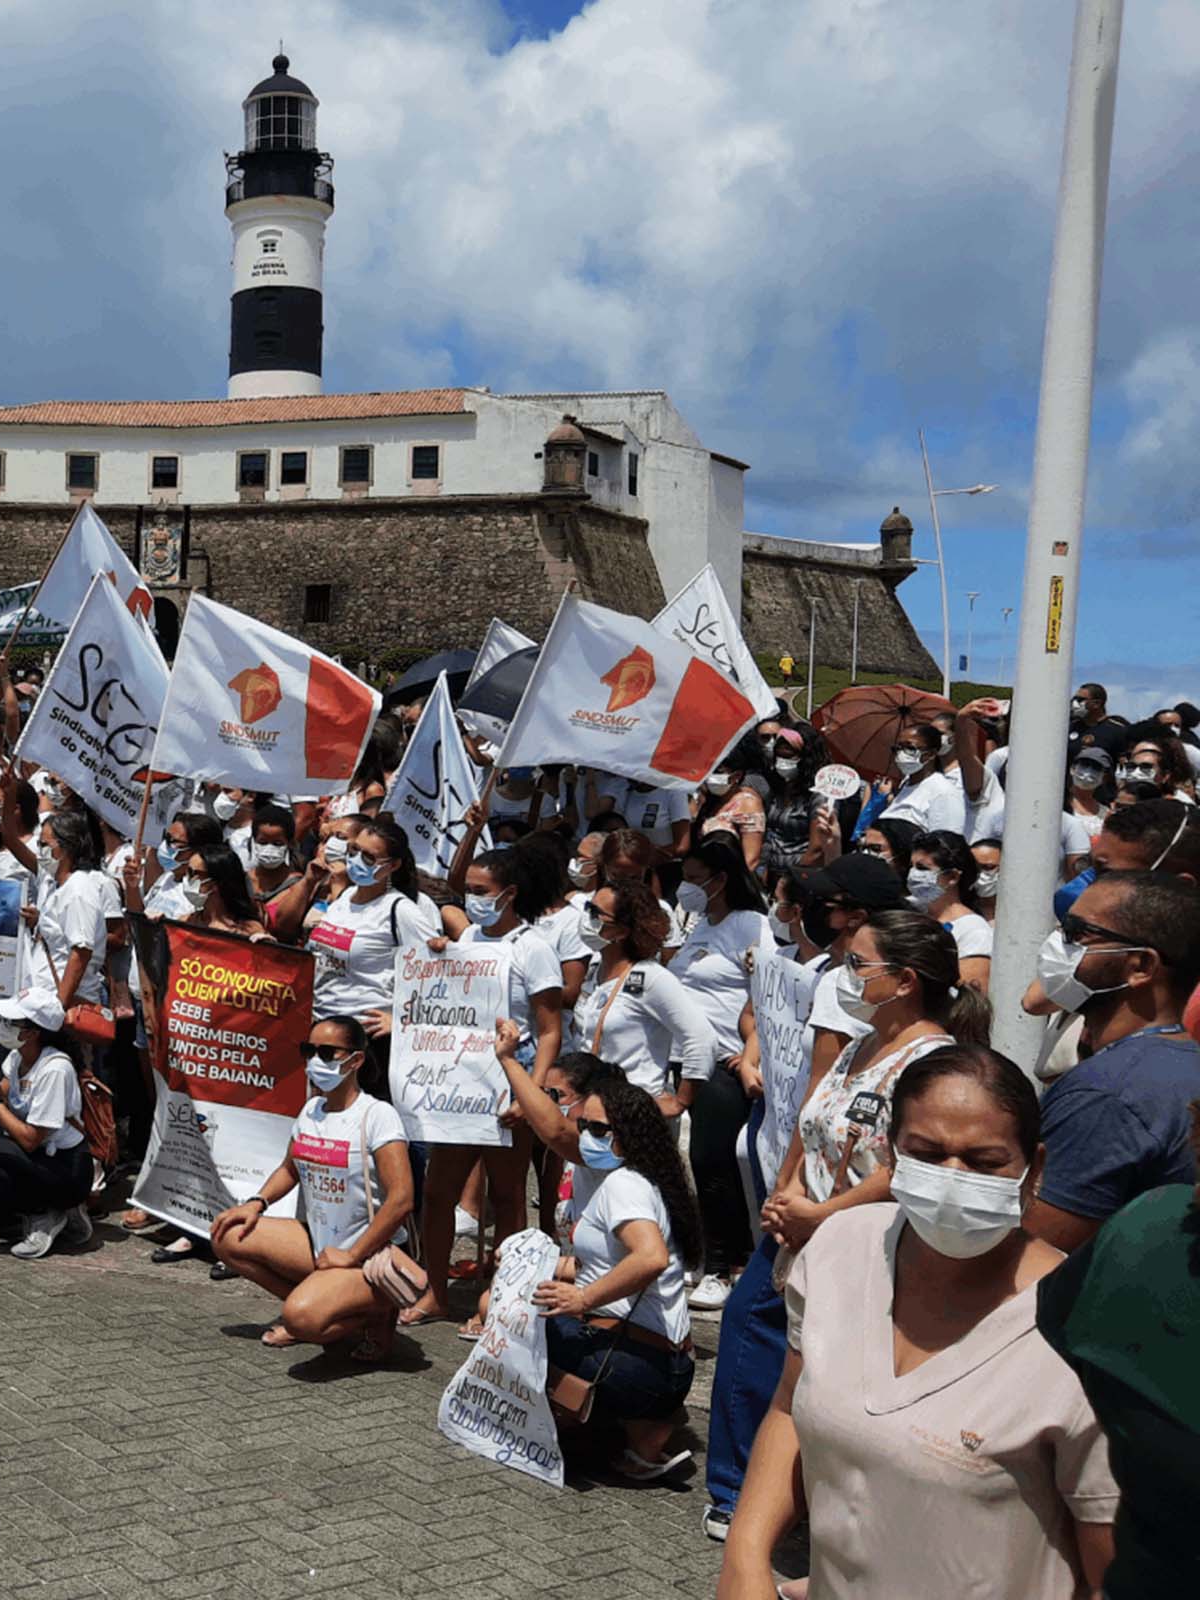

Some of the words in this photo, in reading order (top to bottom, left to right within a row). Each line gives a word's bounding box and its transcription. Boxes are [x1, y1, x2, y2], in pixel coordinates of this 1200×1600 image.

[179, 957, 202, 978] SÓ
[202, 963, 296, 1002] CONQUISTA
[175, 978, 219, 1002] QUEM
[221, 987, 279, 1016] LUTA!
[168, 1018, 267, 1051] ENFERMEIROS
[220, 1050, 260, 1069] PELA
[208, 1063, 275, 1090] BAIANA!
